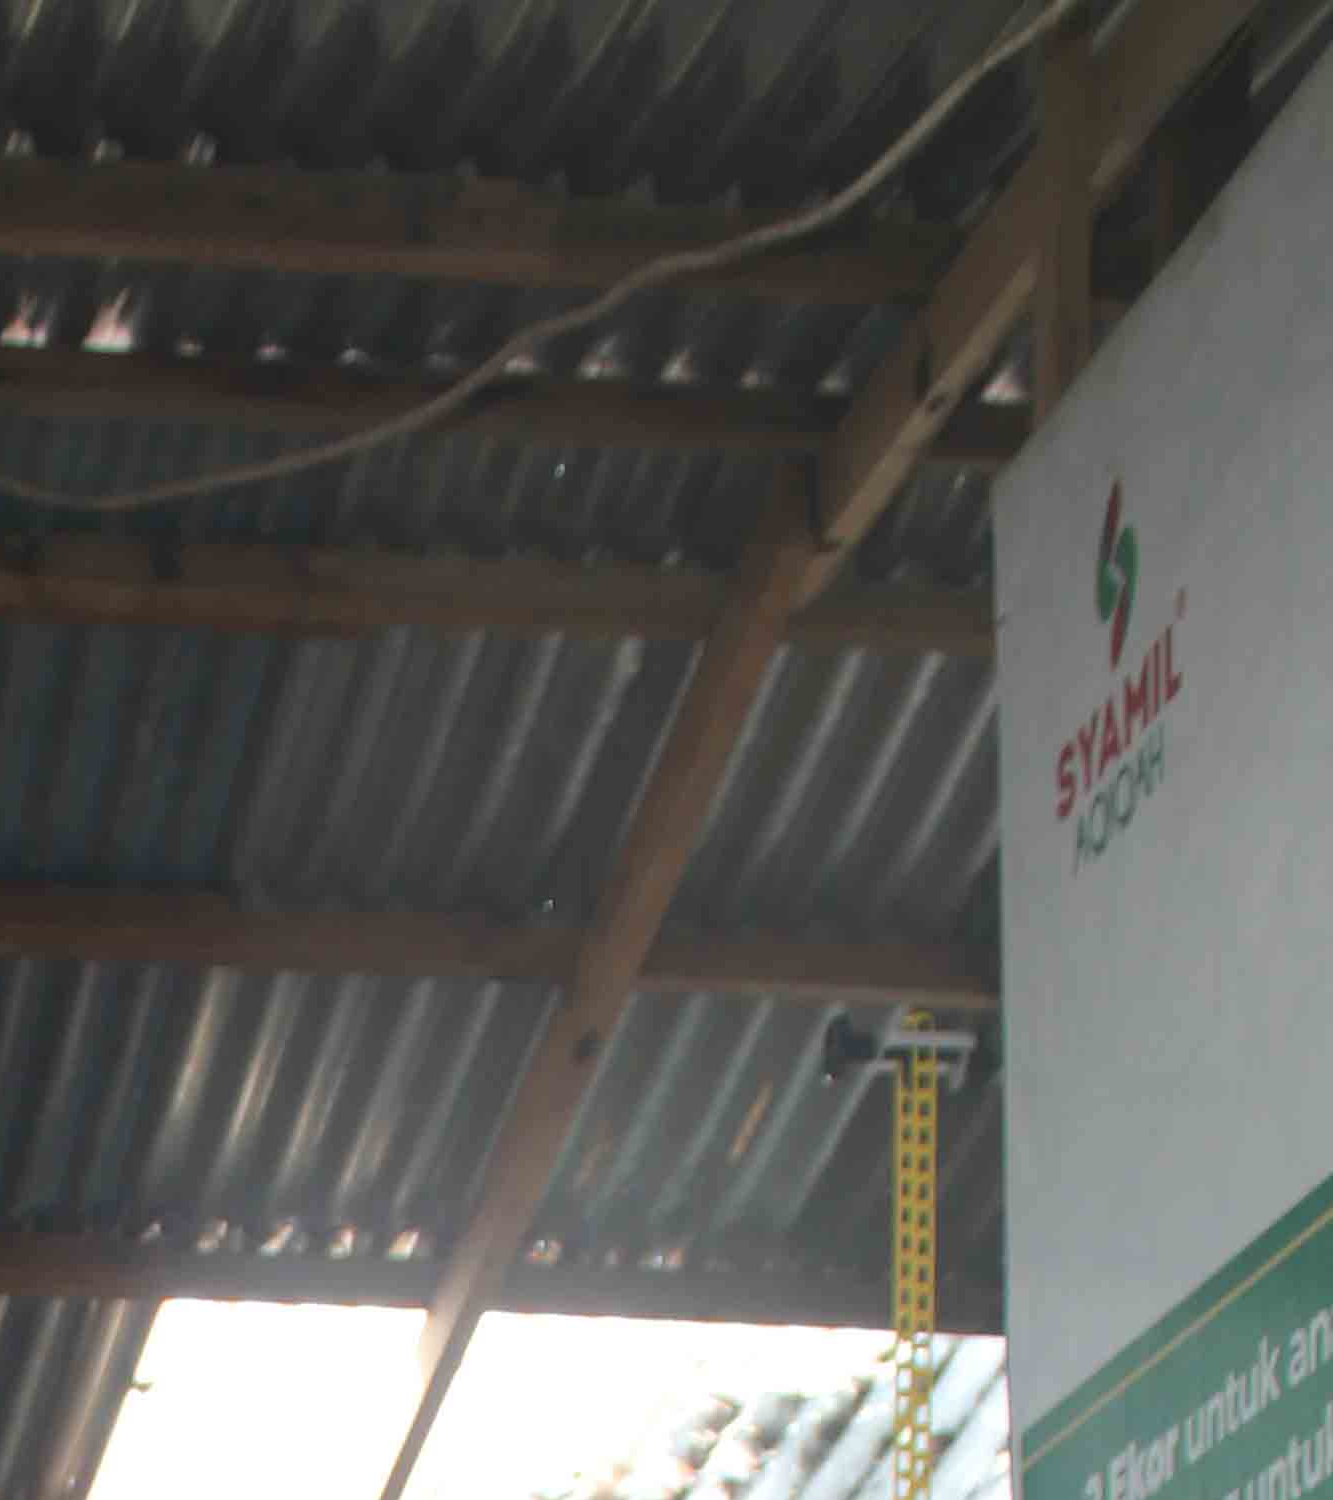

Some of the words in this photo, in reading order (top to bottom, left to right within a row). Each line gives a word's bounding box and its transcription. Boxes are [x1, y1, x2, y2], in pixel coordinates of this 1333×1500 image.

[1055, 624, 1182, 820] SYAMIL
[1184, 1336, 1281, 1464] untuk
[1287, 1305, 1333, 1390] an
